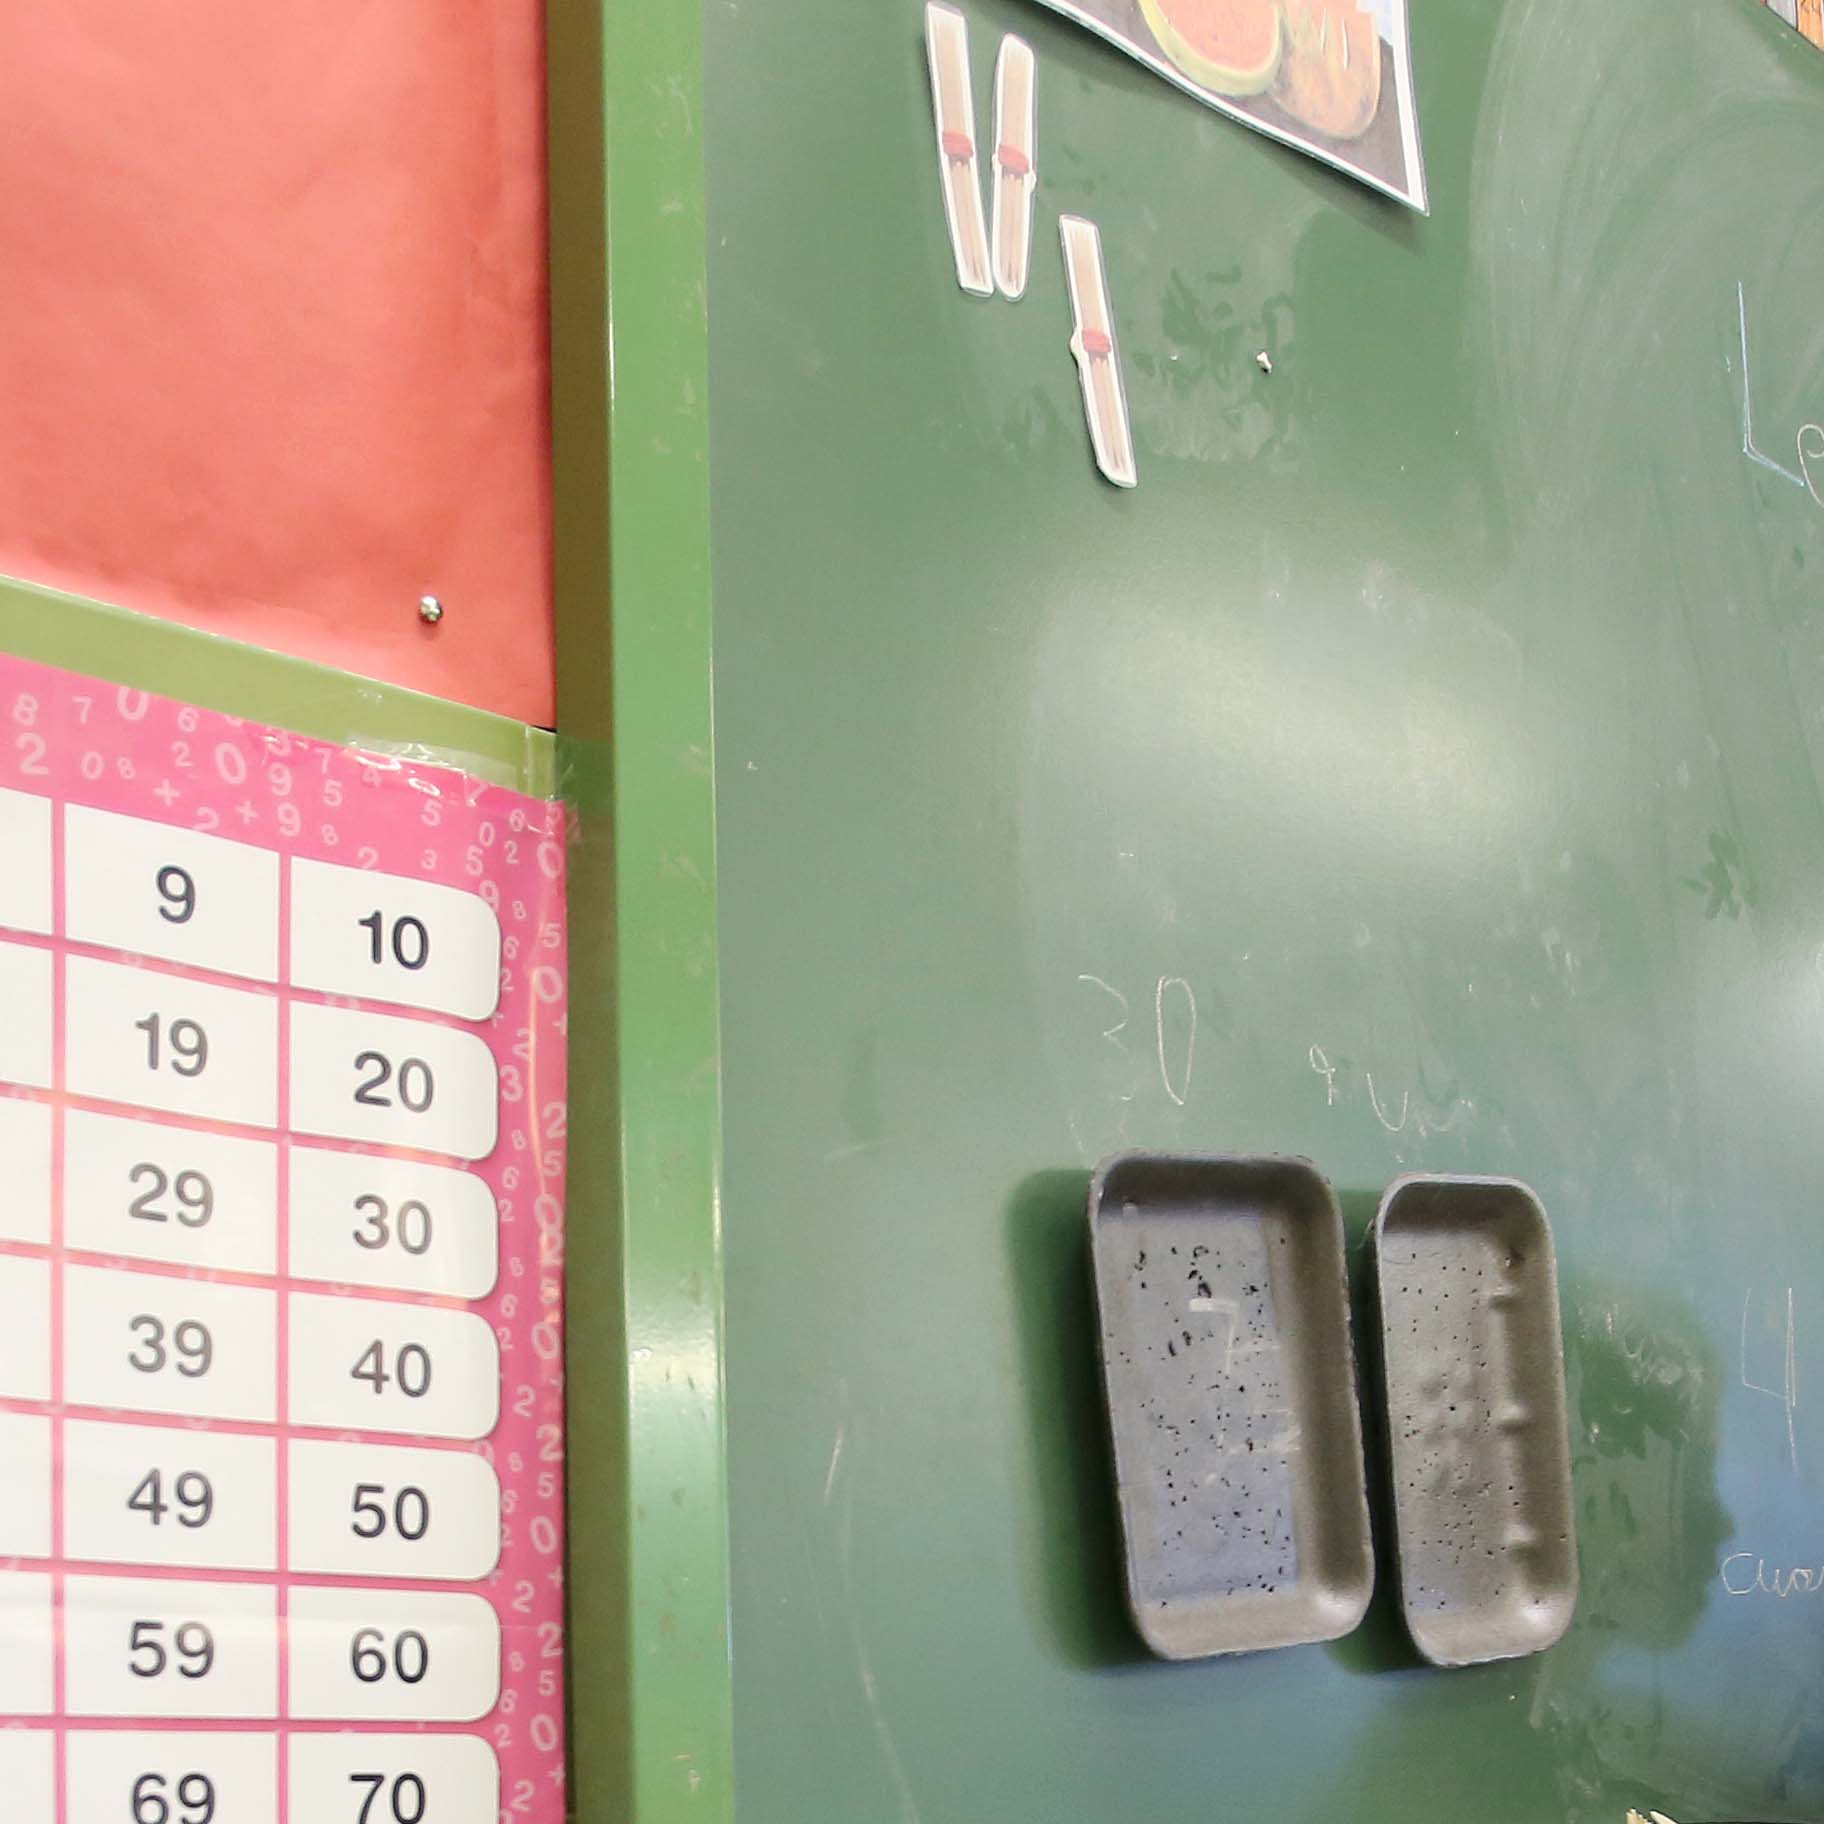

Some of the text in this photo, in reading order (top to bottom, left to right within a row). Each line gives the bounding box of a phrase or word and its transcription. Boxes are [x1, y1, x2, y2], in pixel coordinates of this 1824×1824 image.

[154, 864, 198, 926] 9
[358, 910, 431, 972] 10
[134, 1012, 210, 1079] 19
[352, 1049, 436, 1114] 20
[127, 1161, 215, 1230] 29
[351, 1192, 434, 1257] 30
[127, 1313, 215, 1380] 39
[349, 1338, 434, 1400] 40
[125, 1468, 216, 1530] 49
[350, 1482, 432, 1543] 50
[128, 1618, 216, 1681] 59
[349, 1629, 431, 1687] 60
